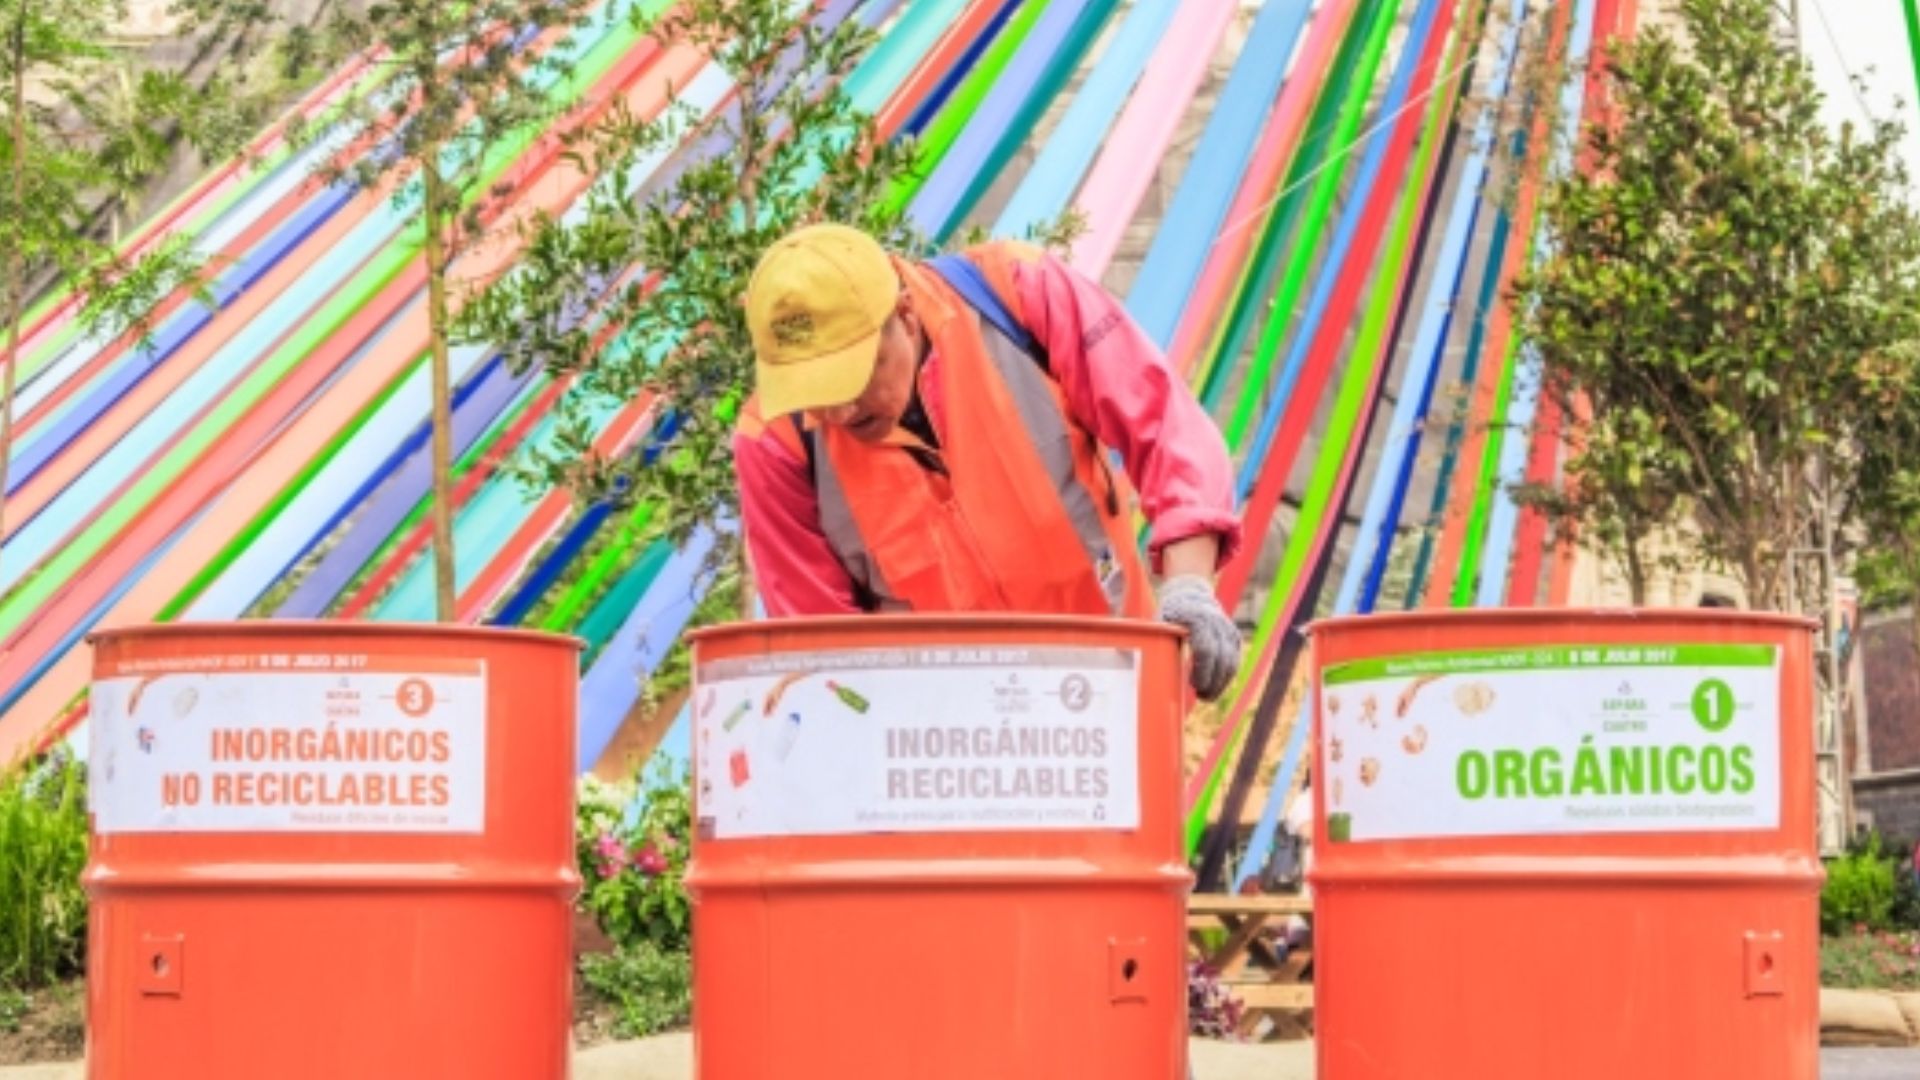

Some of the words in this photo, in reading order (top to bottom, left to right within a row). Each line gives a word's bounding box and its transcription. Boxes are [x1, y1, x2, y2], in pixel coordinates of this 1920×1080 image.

[405, 683, 424, 711] 3
[1066, 681, 1082, 708] 2
[1702, 686, 1719, 723] 1
[211, 721, 451, 763] INORGÁNICOS
[886, 718, 1108, 759] INORGÁNICOS
[887, 766, 1109, 800] RECICLABLES
[1455, 735, 1755, 799] ORGÁNICOS
[162, 773, 200, 806] NO
[213, 773, 450, 806] RECICLABLES
